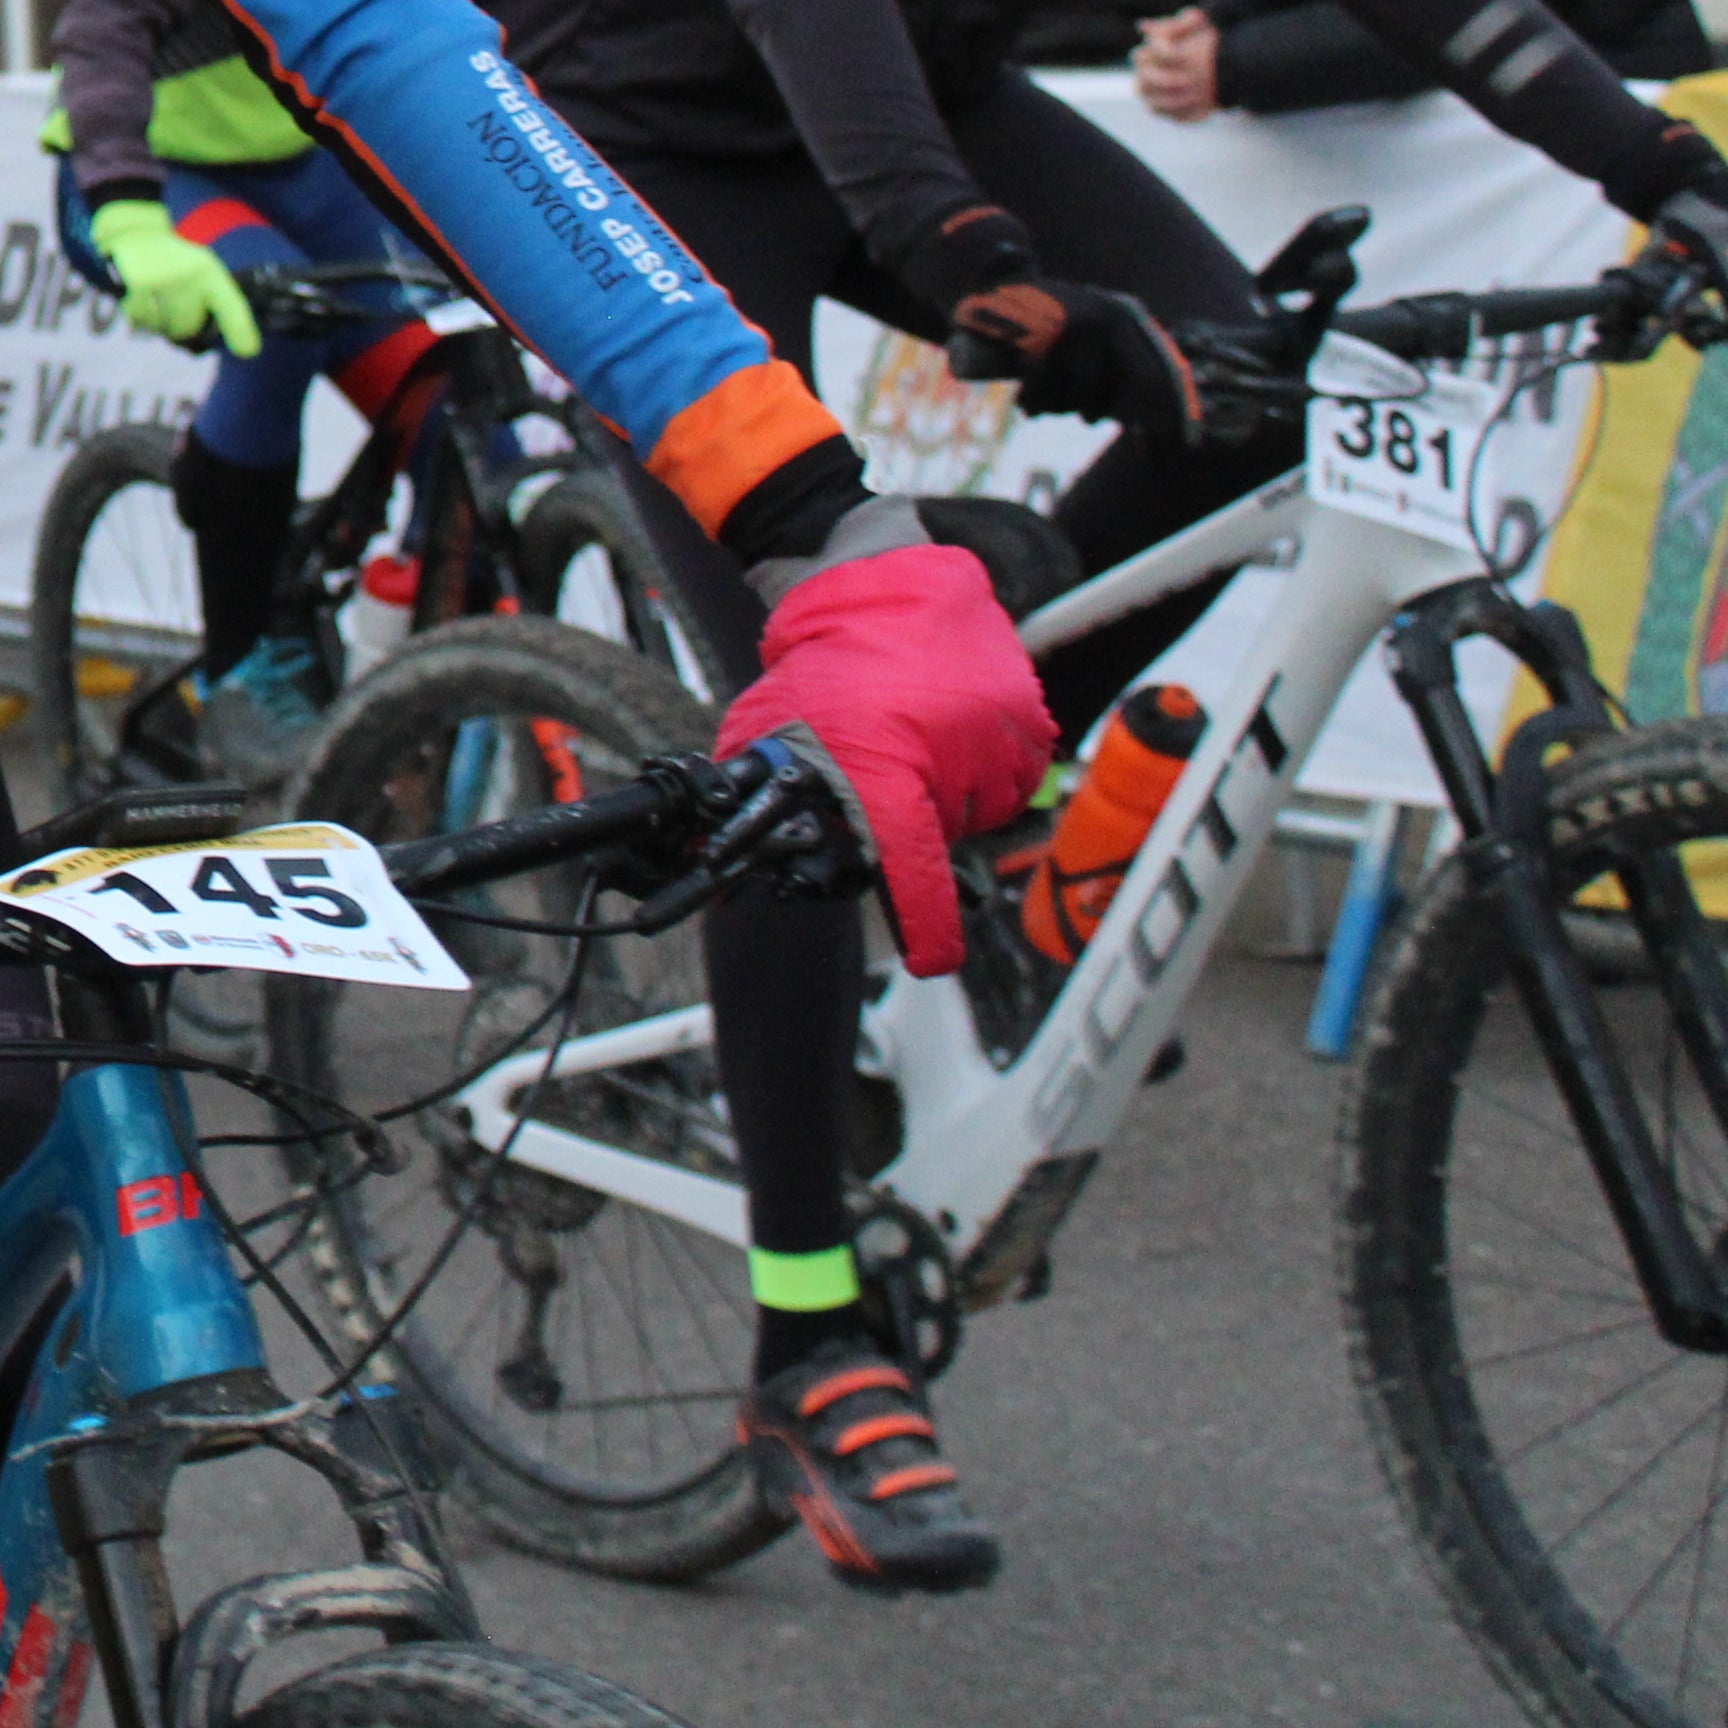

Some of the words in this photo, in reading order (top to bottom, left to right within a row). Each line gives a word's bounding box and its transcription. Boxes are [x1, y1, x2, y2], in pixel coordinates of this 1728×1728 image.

[468, 50, 611, 212] CARRERAS
[466, 110, 629, 292] FUNDACIÓN
[600, 217, 695, 305] JOSEP
[1334, 395, 1453, 492] 381
[86, 855, 369, 929] 145
